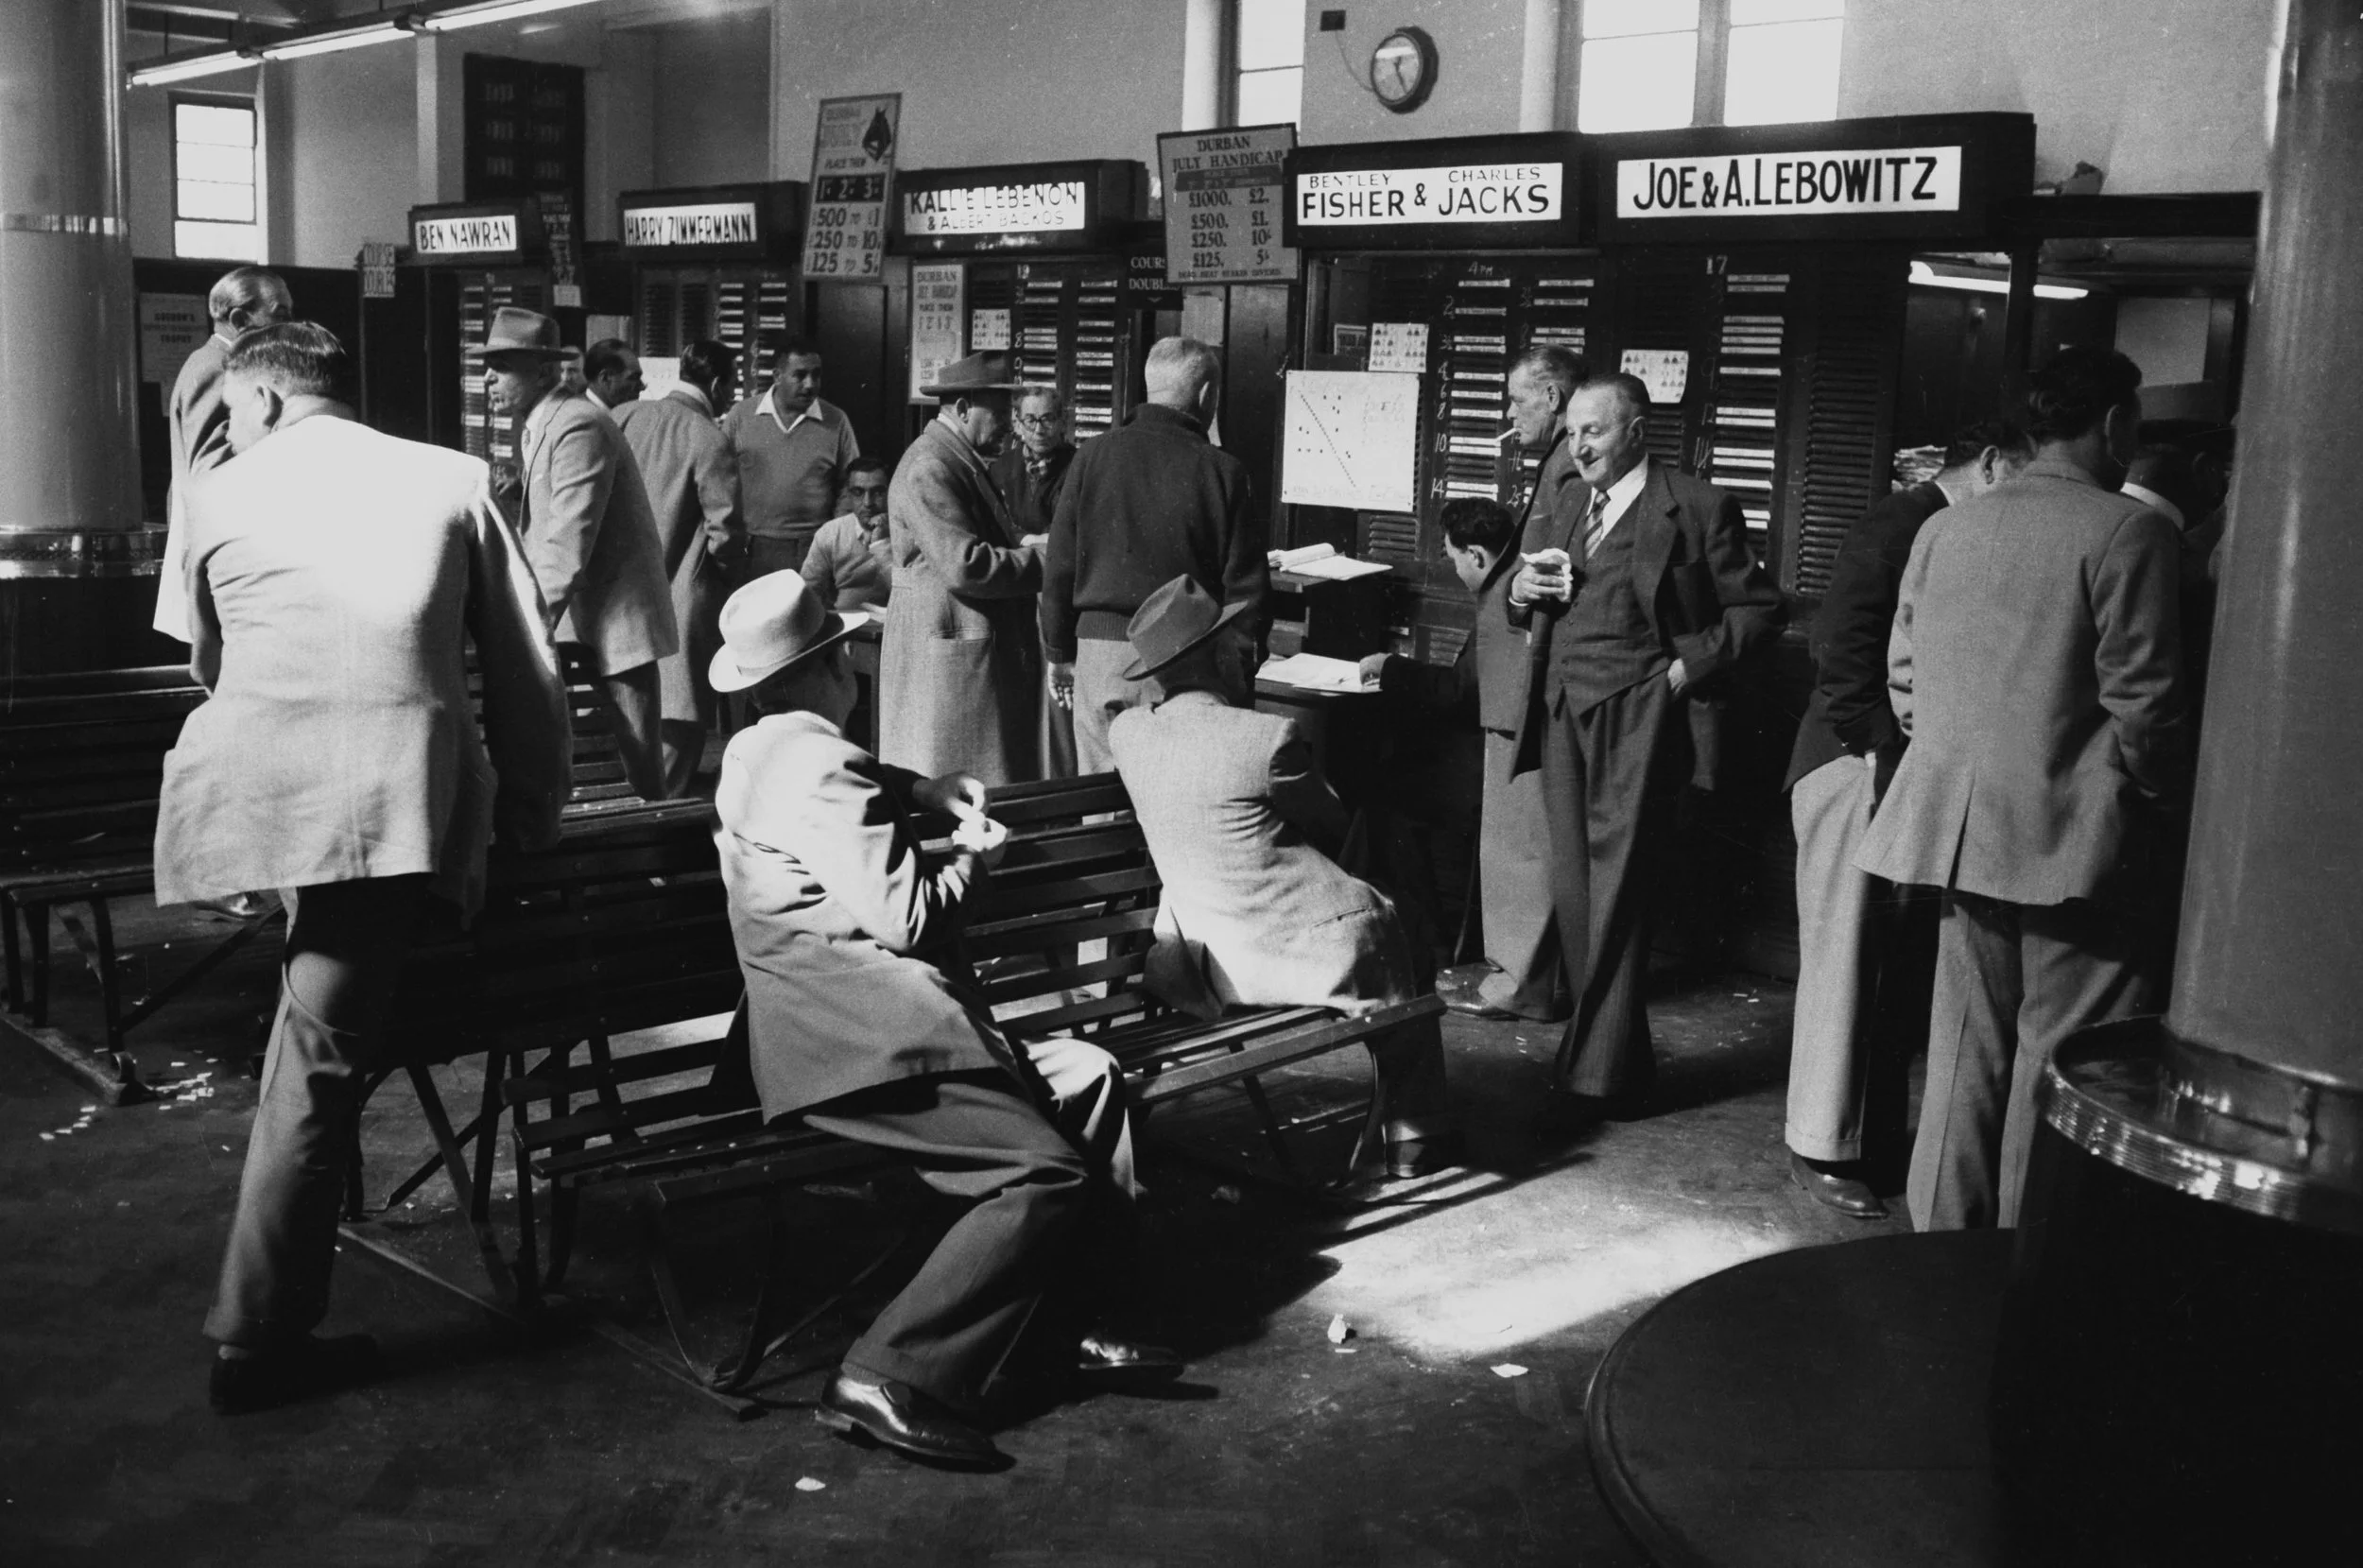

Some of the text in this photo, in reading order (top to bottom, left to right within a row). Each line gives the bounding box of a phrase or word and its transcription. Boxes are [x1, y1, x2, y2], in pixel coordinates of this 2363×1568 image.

[1197, 135, 1250, 152] DURBAN
[1172, 149, 1284, 173] JULY HANDICAP
[1309, 166, 1542, 189] BENTLEY CHARLES
[1302, 182, 1549, 218] FISHER & JACKS
[926, 215, 937, 232] &
[420, 220, 510, 250] BEN NAWRAN
[1130, 257, 1167, 269] COUR
[1706, 254, 1728, 275] 17
[1435, 432, 1448, 453] 10
[1430, 476, 1445, 500] 14
